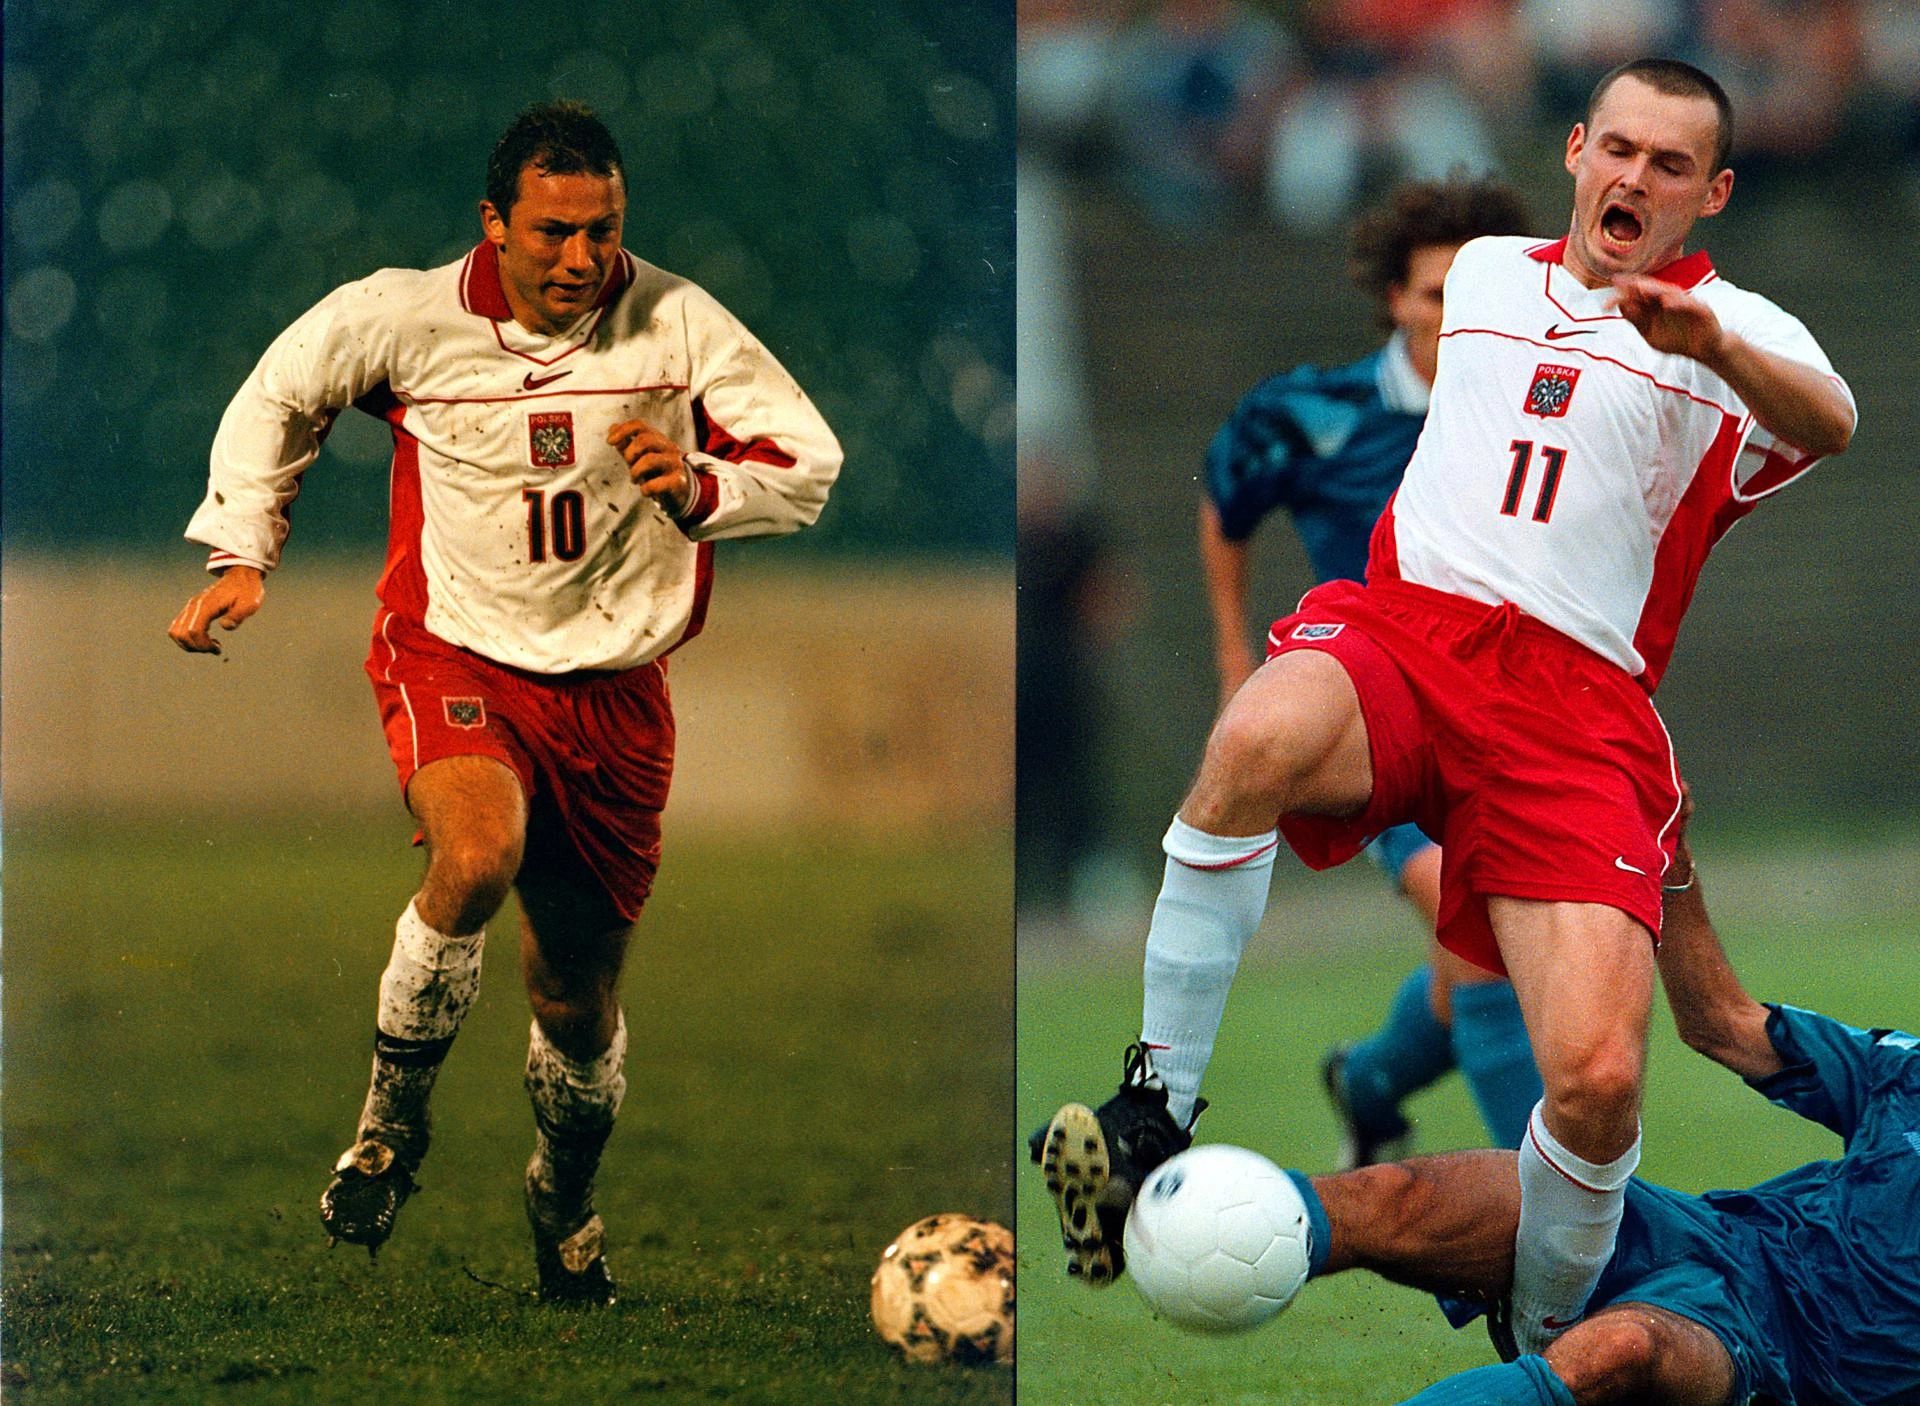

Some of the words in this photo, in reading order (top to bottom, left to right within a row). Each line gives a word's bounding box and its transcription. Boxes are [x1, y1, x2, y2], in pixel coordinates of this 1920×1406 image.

[1538, 365, 1576, 377] POLSKA
[530, 414, 569, 424] POLSKA
[1500, 439, 1568, 523] 11
[522, 489, 586, 563] 10
